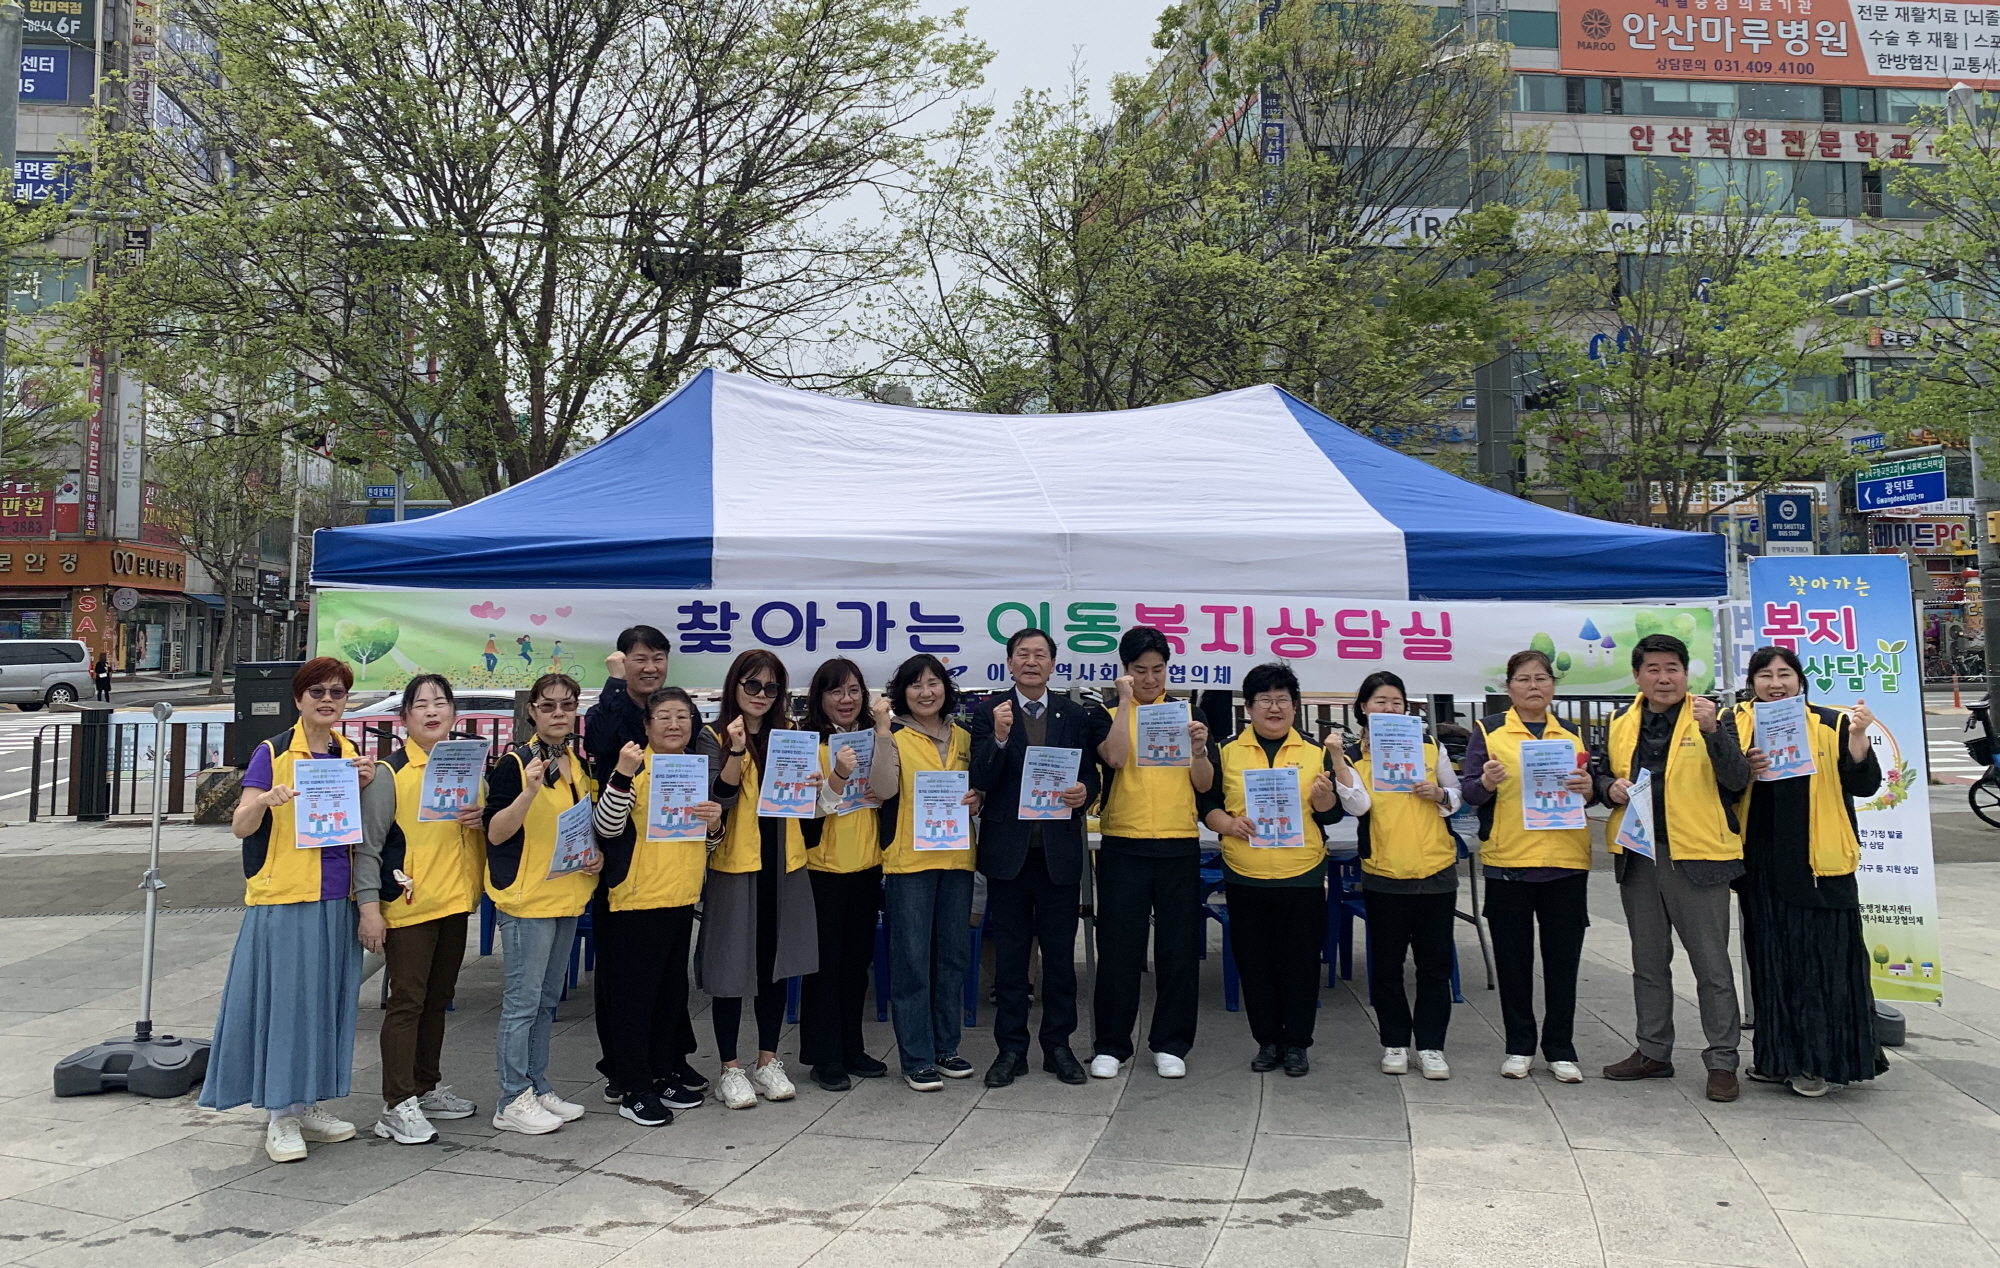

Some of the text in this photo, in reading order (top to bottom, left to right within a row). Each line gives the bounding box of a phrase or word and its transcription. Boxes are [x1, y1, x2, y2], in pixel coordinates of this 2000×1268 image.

[30, 1, 82, 14] 한대역점
[1857, 5, 1889, 21] 전문
[1895, 6, 1958, 24] 재활치료
[57, 17, 81, 34] 6F
[1622, 13, 1848, 57] 안산마루병원
[1577, 41, 1616, 51] MAROO
[1869, 30, 1900, 46] 수술
[1906, 31, 1922, 47] 후
[1927, 32, 1959, 49] 재활
[1655, 58, 1815, 75] 상담문의 031.409.4100
[1877, 53, 1938, 71] 한방협진
[1952, 56, 2000, 74] 교통사
[1630, 125, 1914, 160] 안산직업전문학교
[1885, 479, 1915, 495] 광덕1로
[1789, 575, 1871, 597] 찾아가는
[677, 600, 966, 654] 찾아가는
[1762, 602, 1856, 656] 복지
[1803, 653, 1902, 693] 상담실
[1870, 830, 1886, 839] 가정
[1869, 842, 1884, 850] 상담
[1858, 865, 1874, 873] 가구
[1876, 865, 1884, 873] 등
[1903, 866, 1919, 875] 상담
